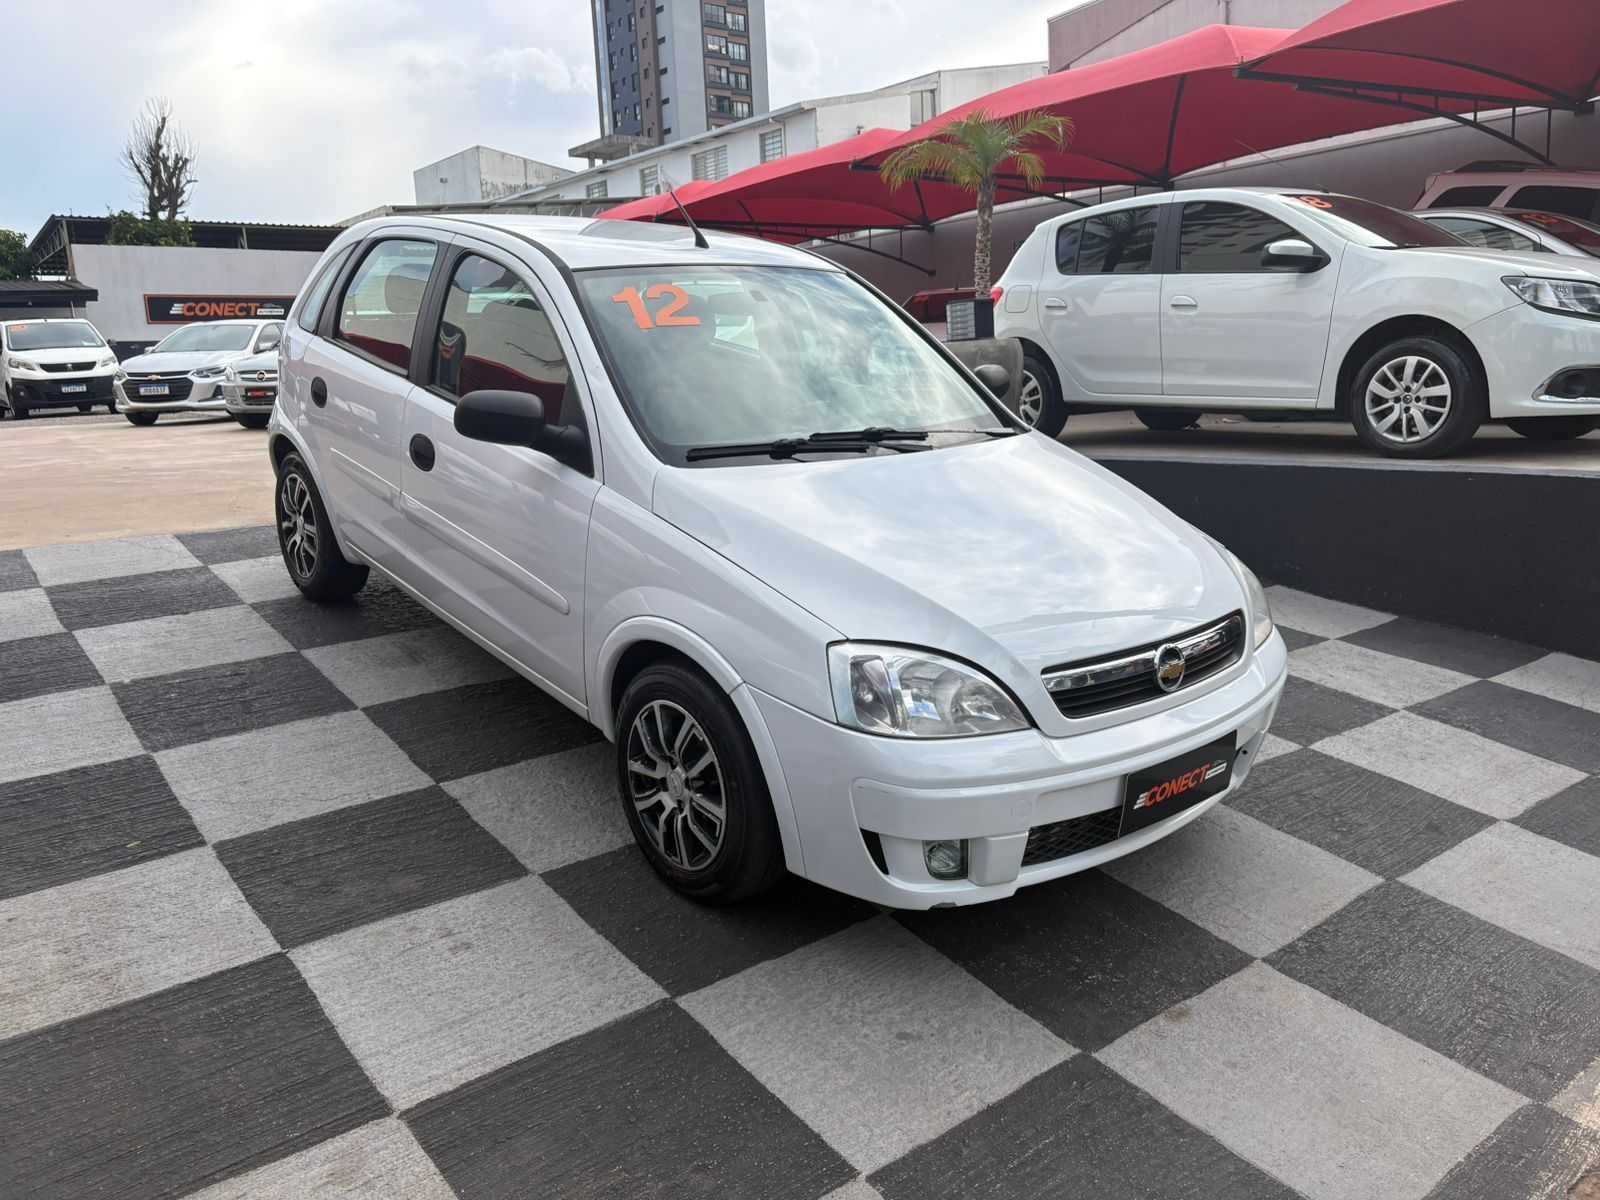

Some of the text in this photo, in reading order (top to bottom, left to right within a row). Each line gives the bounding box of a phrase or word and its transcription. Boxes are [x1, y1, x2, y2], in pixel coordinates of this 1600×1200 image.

[183, 302, 259, 316] CONECT
[612, 284, 701, 329] 12
[1145, 763, 1211, 807] CONECT
